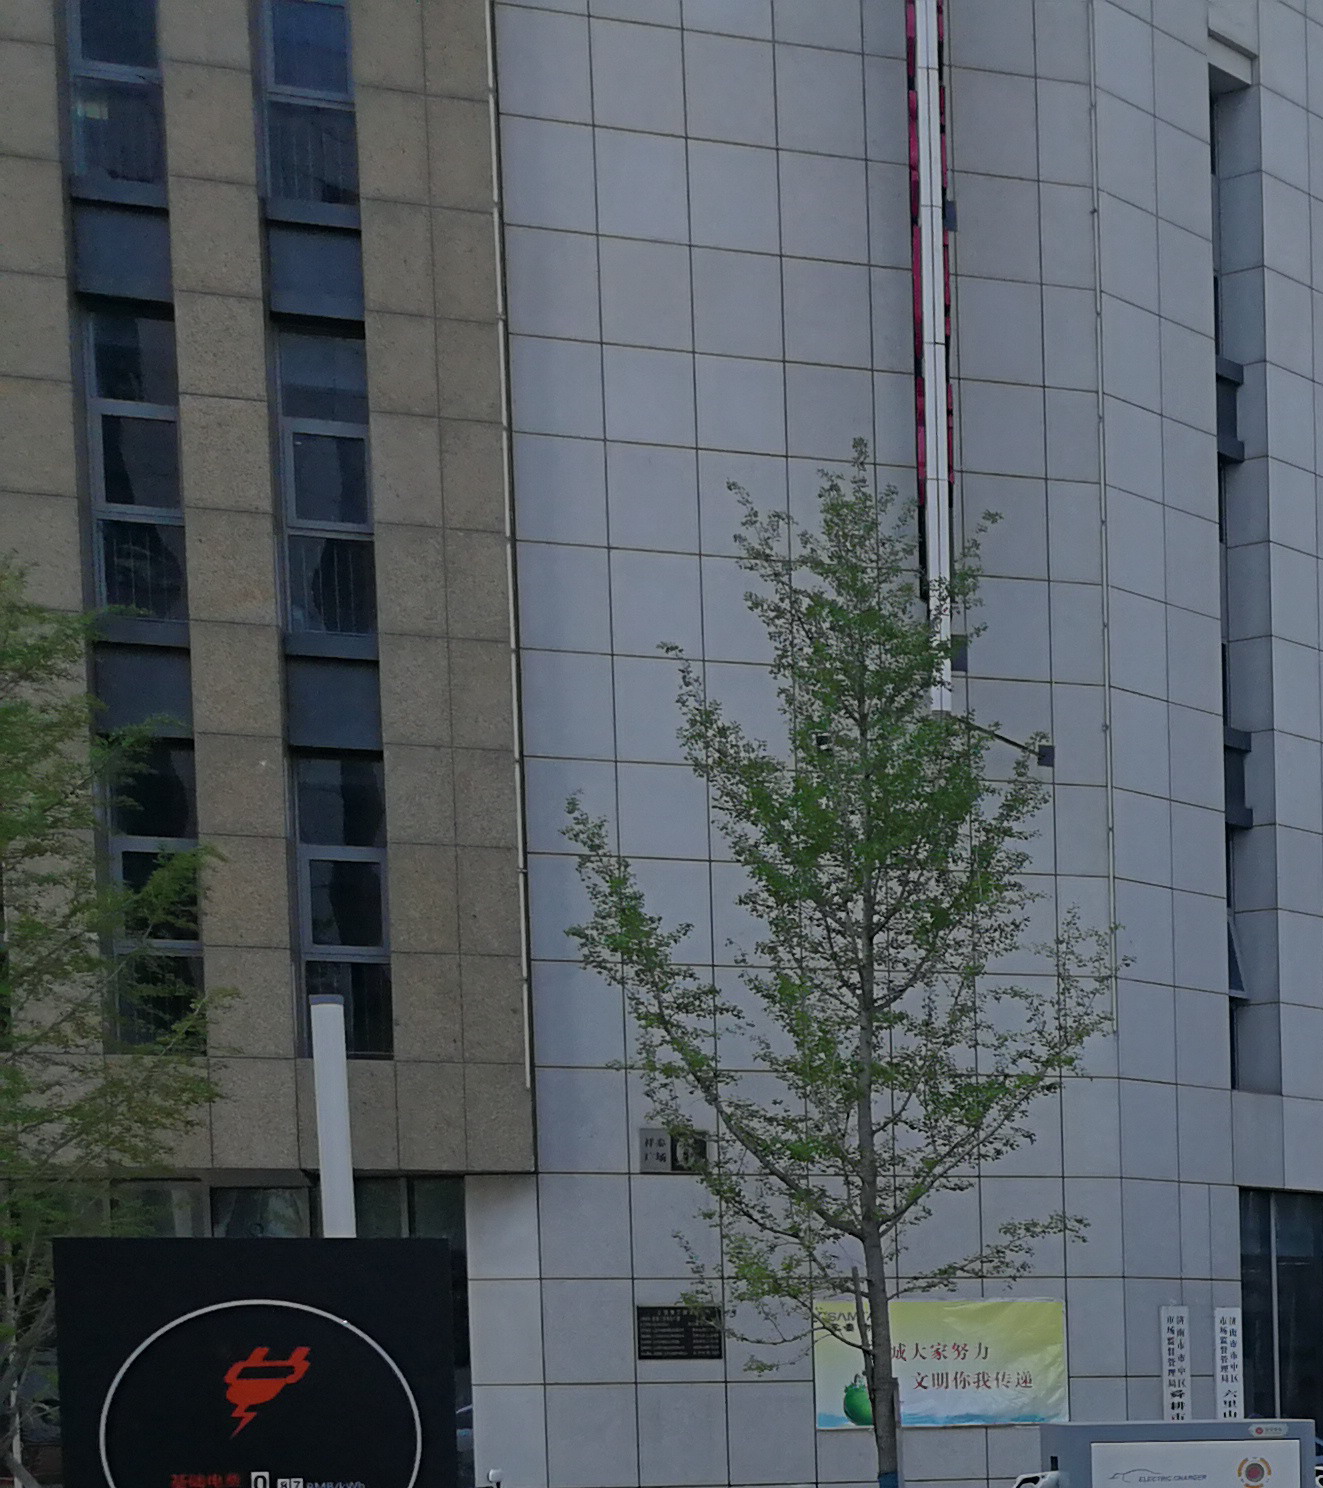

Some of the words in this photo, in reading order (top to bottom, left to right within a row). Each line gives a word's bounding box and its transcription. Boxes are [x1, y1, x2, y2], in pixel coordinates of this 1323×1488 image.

[913, 1371, 1033, 1390] 文明你我传递
